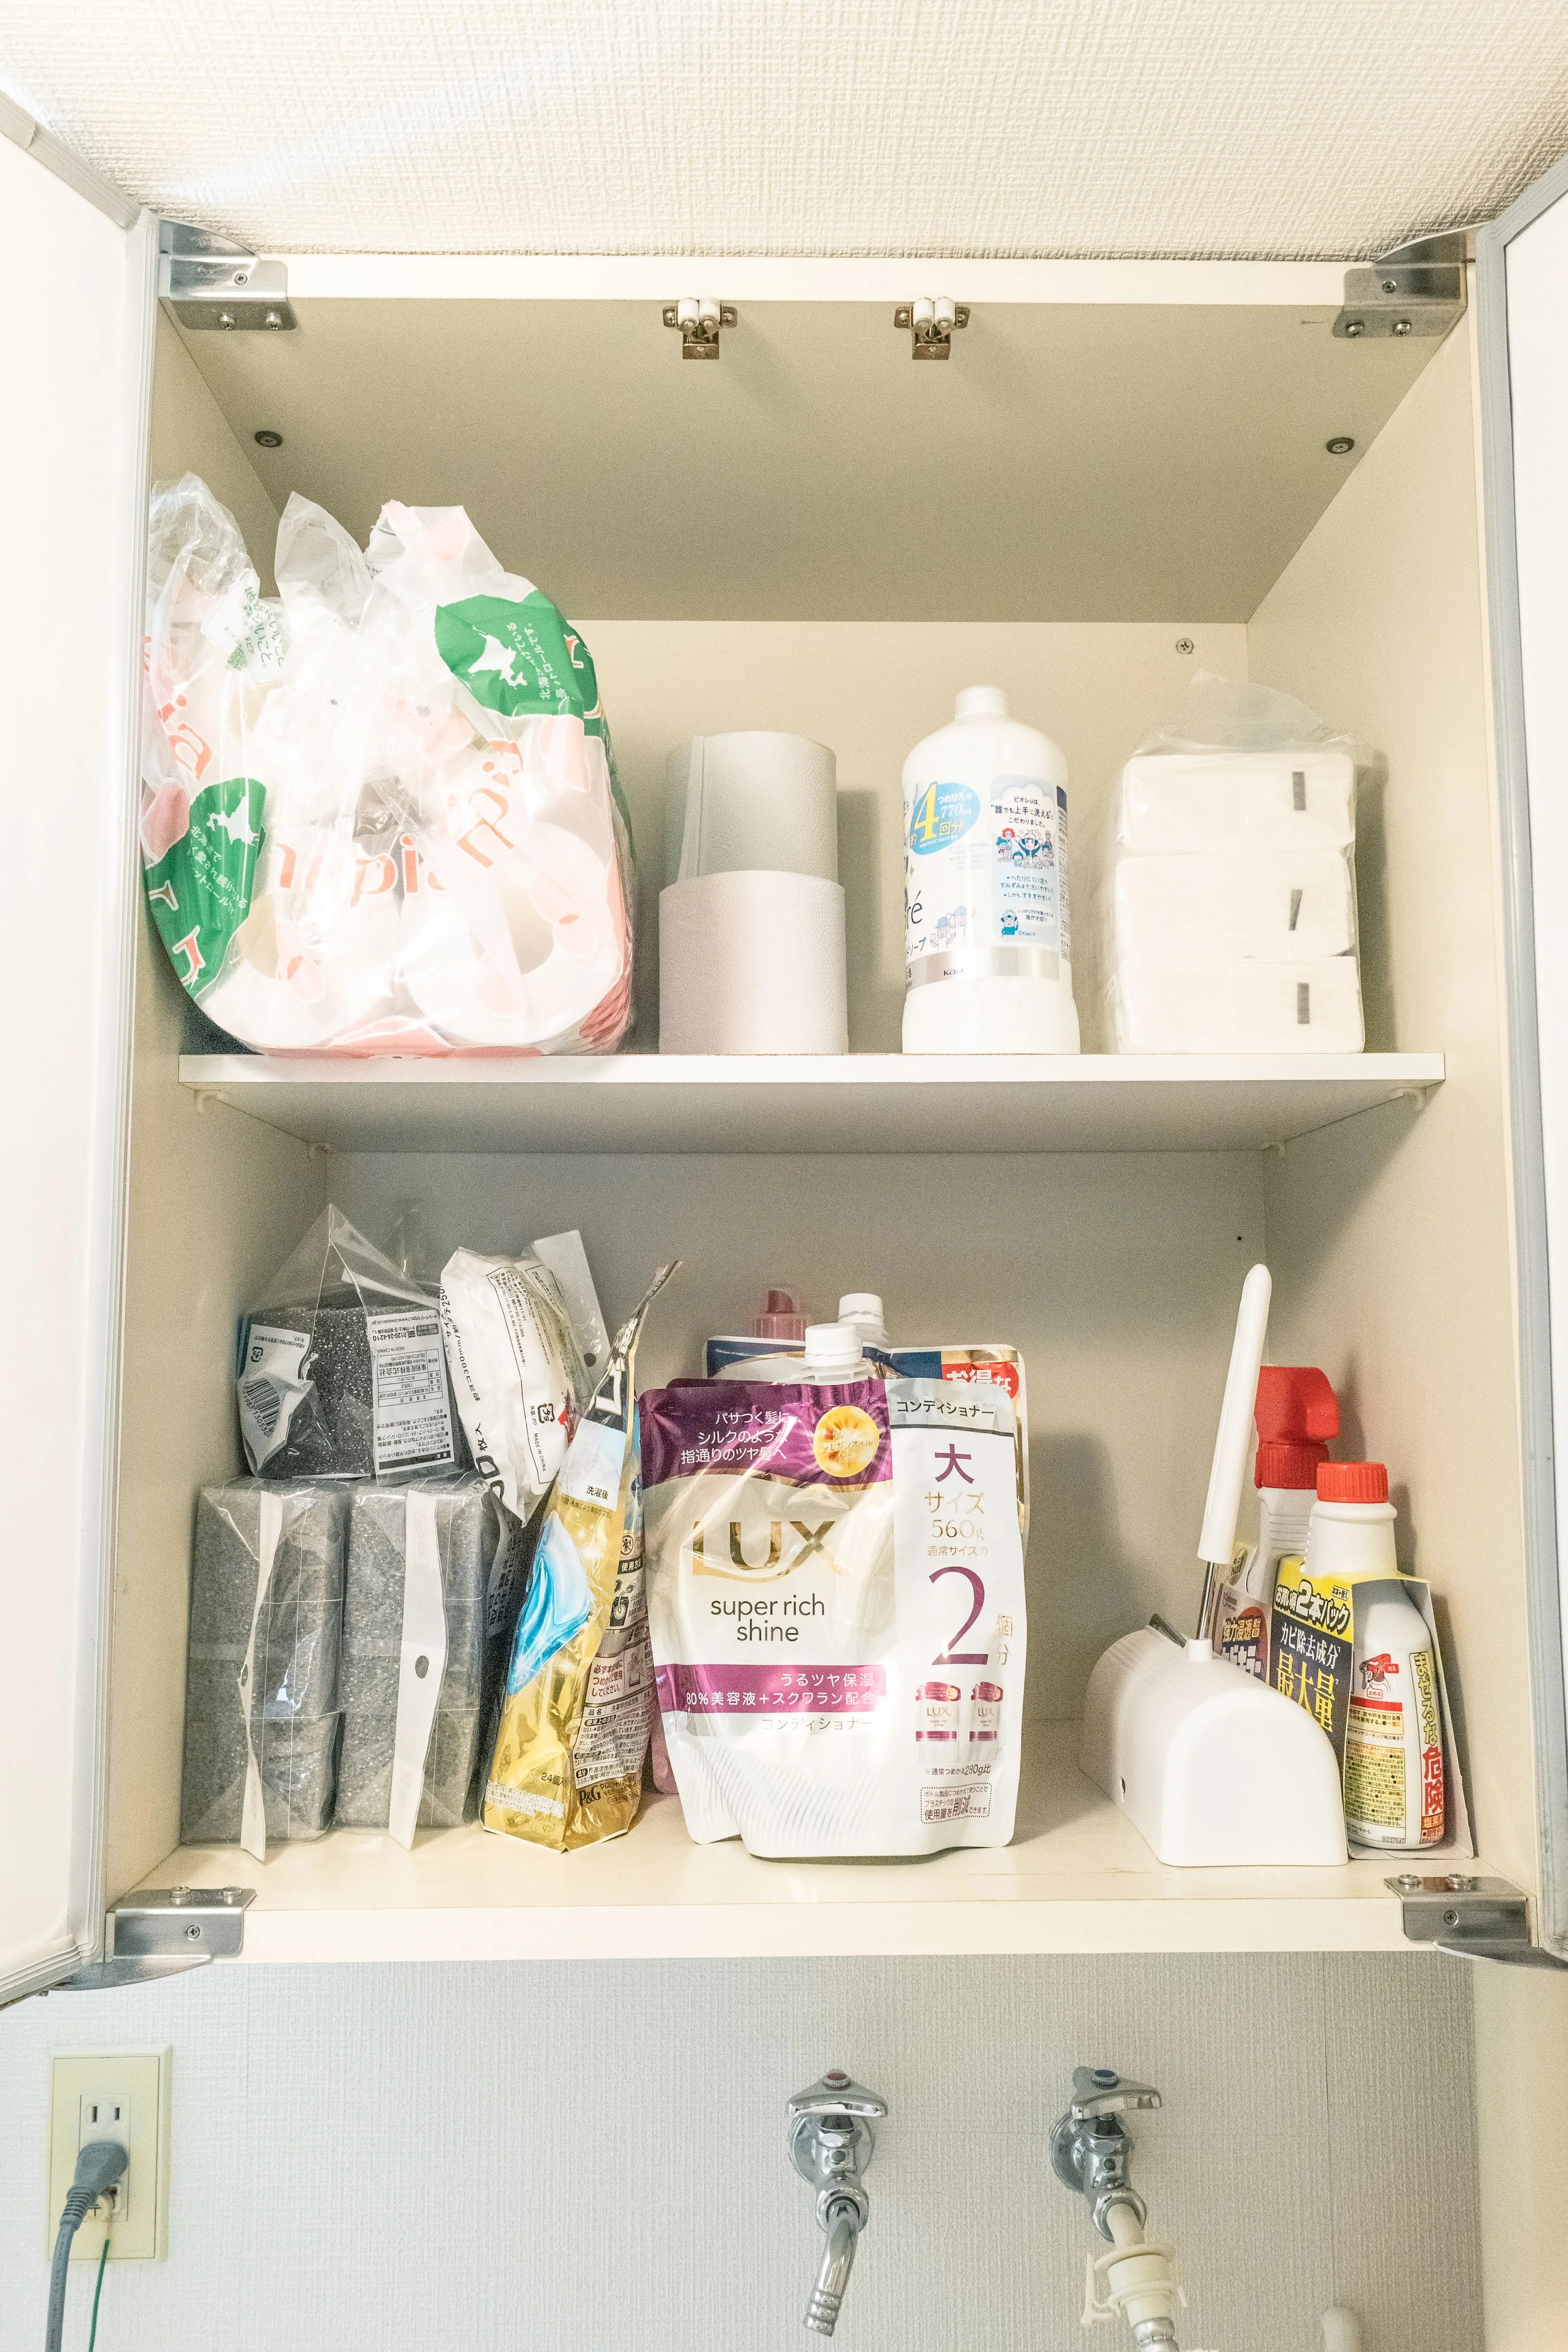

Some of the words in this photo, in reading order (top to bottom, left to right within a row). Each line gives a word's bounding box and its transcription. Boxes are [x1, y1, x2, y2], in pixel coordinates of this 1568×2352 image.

[1009, 817, 1045, 827] こだわりました。
[513, 1304, 525, 1338] 0120-713-968
[373, 1332, 407, 1341] 0120-24-4210
[379, 1363, 426, 1376] 東和産業株式会社
[716, 1411, 790, 1425] パサつく髪に
[896, 1400, 995, 1418] コンディショナー
[698, 1430, 788, 1445] シルクのような
[681, 1446, 788, 1464] 指通りのツヤ髪へ
[838, 1452, 855, 1464] 配合
[934, 1443, 974, 1484] 大
[586, 1485, 609, 1500] 洗濯後
[924, 1491, 985, 1515] サイズ
[932, 1519, 984, 1541] 560g
[692, 1521, 851, 1583] LUX
[927, 1545, 988, 1556] 通常サイズの
[710, 1600, 778, 1622] super
[784, 1593, 825, 1616] rich
[929, 1566, 988, 1665] 2
[737, 1618, 799, 1642] shine
[1223, 1618, 1252, 1642] 強力浸透
[1280, 1622, 1338, 1670] カビ除去成分
[781, 1673, 875, 1687] うるツヤ保湿
[592, 1685, 620, 1697] してください。
[1414, 1653, 1438, 1746] まぜるな
[927, 1707, 951, 1717] LUX
[978, 1708, 994, 1718] LUX
[762, 1717, 874, 1731] コンディショナー
[1422, 1746, 1443, 1815] 危険
[579, 1785, 601, 1806] P&G
[924, 1798, 954, 1807] プラスチックの
